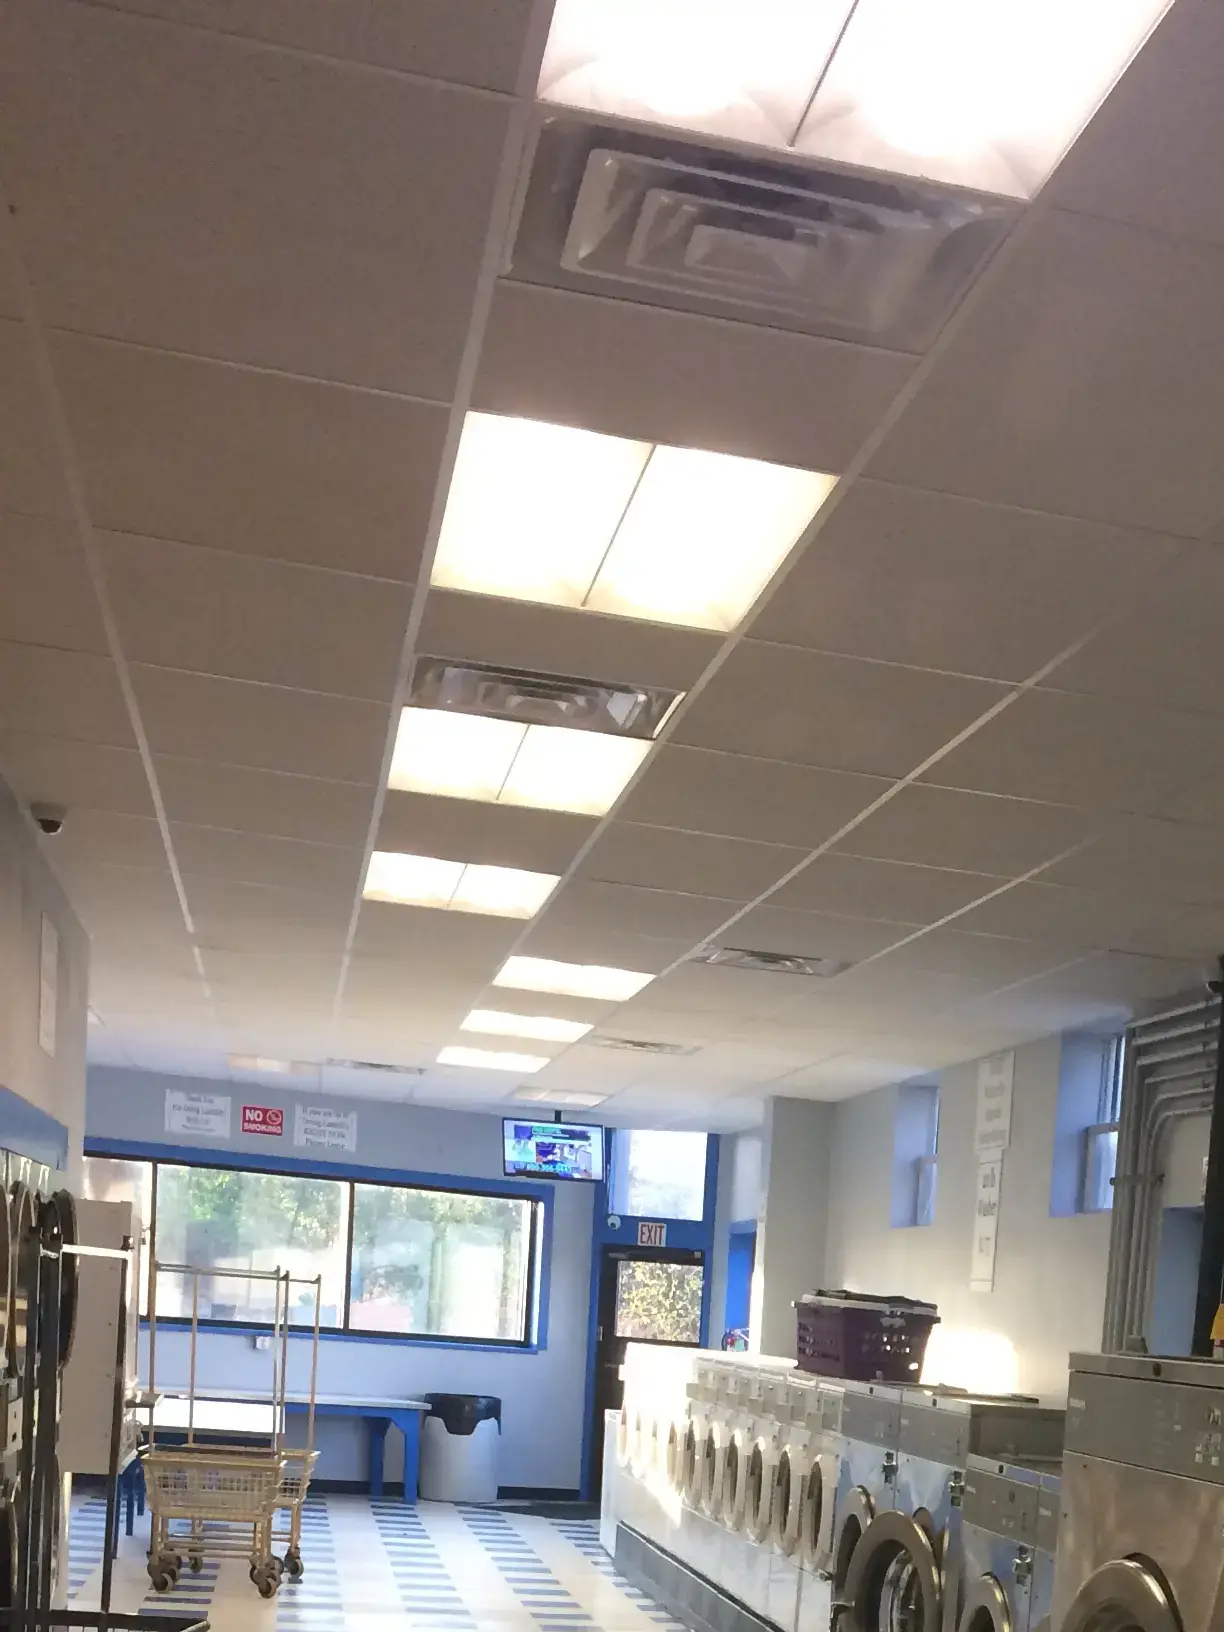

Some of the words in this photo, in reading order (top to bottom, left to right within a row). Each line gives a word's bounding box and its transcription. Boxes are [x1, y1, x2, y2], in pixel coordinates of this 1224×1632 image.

[245, 1109, 263, 1122] NO
[243, 1123, 282, 1134] SMOKING
[639, 1223, 665, 1245] EXIT
